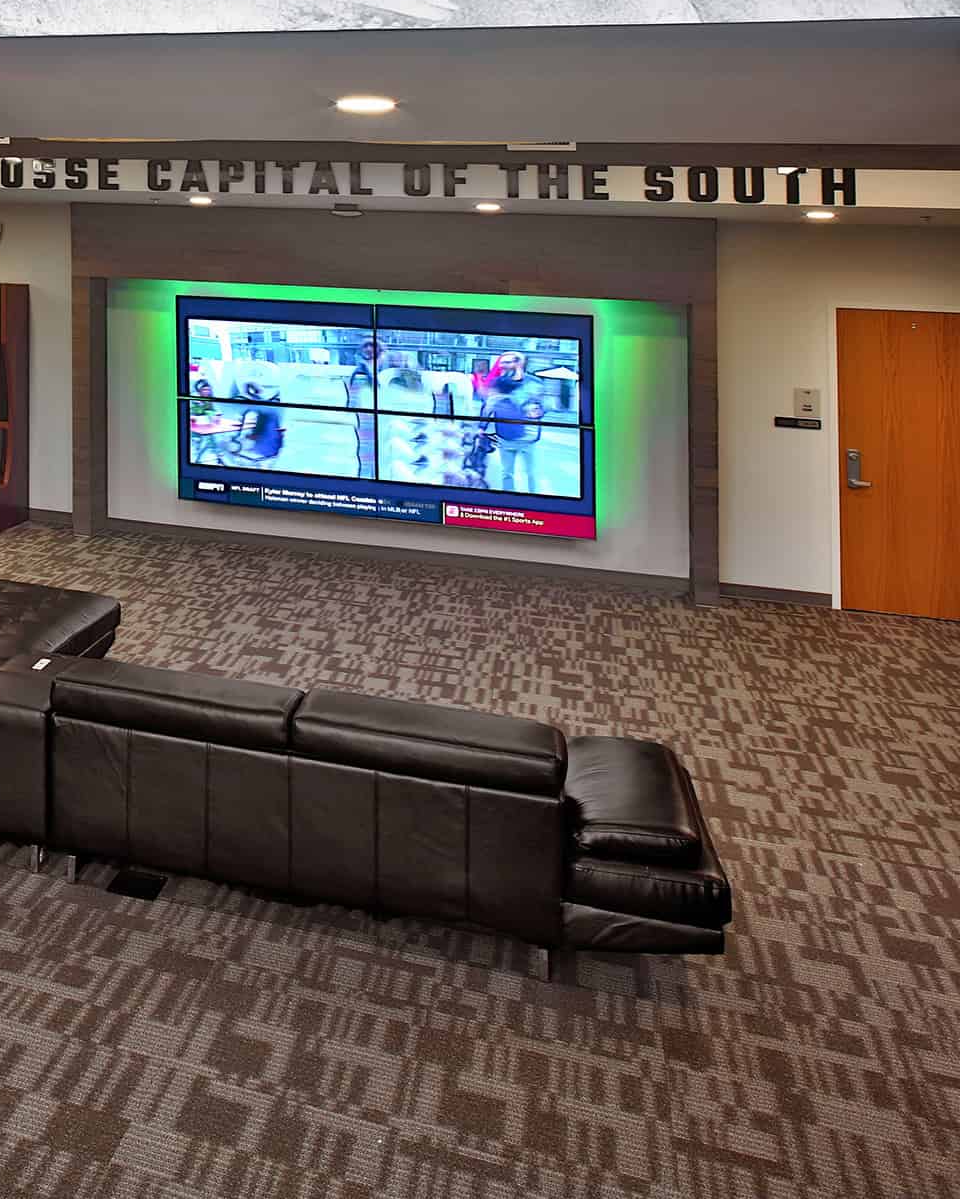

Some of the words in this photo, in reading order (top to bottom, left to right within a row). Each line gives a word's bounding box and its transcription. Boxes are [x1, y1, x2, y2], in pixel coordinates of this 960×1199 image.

[147, 158, 373, 195] CAPITAL
[403, 161, 467, 197] OF
[499, 161, 609, 200] THE
[643, 164, 857, 206] SOUTH
